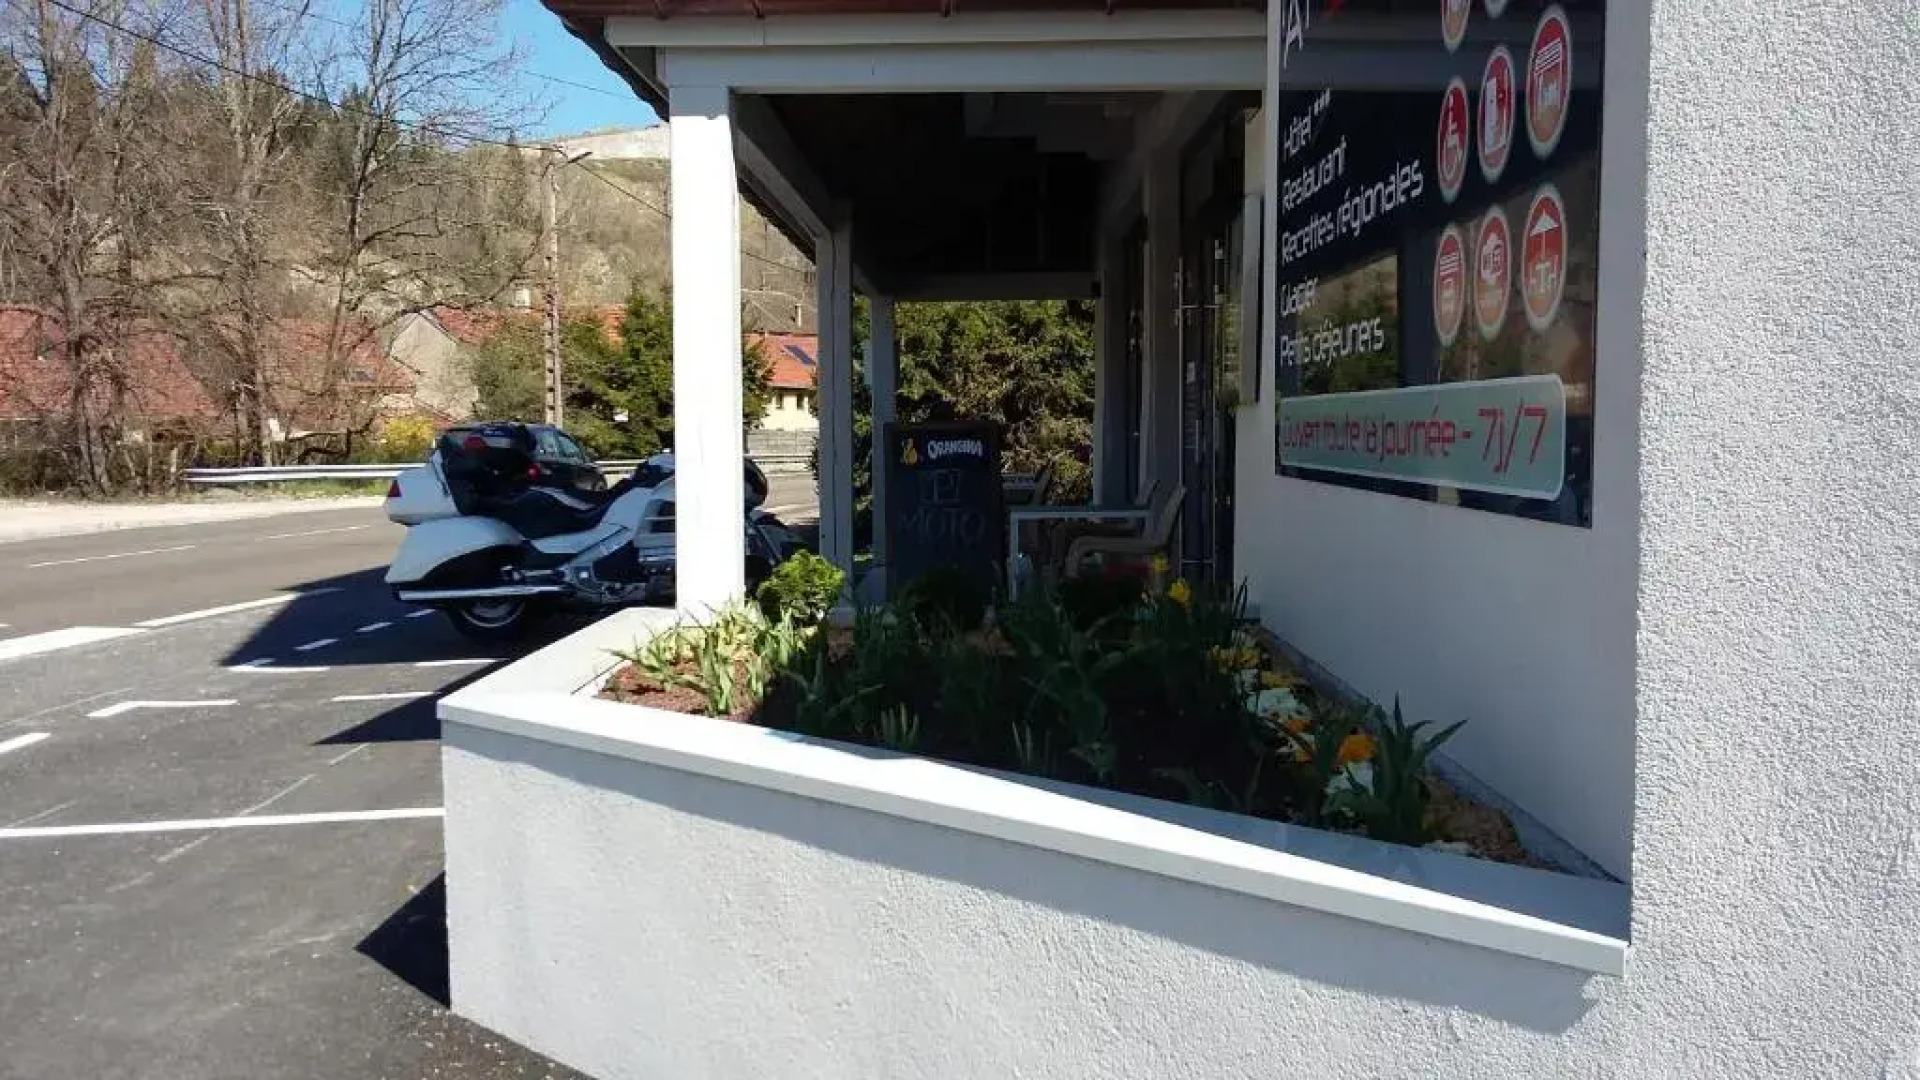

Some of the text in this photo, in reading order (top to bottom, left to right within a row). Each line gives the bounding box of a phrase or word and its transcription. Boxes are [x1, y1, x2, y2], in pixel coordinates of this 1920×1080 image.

[1283, 107, 1312, 161] Hôtel
[1282, 136, 1348, 215] Restaurant
[1281, 160, 1425, 266] Recettes régionales
[1313, 317, 1386, 368] déjeuners
[1321, 413, 1361, 456] toute
[1365, 414, 1378, 453] la
[1380, 404, 1456, 464] journée
[1477, 397, 1548, 474] 7j/7
[898, 506, 985, 546] MOTO
